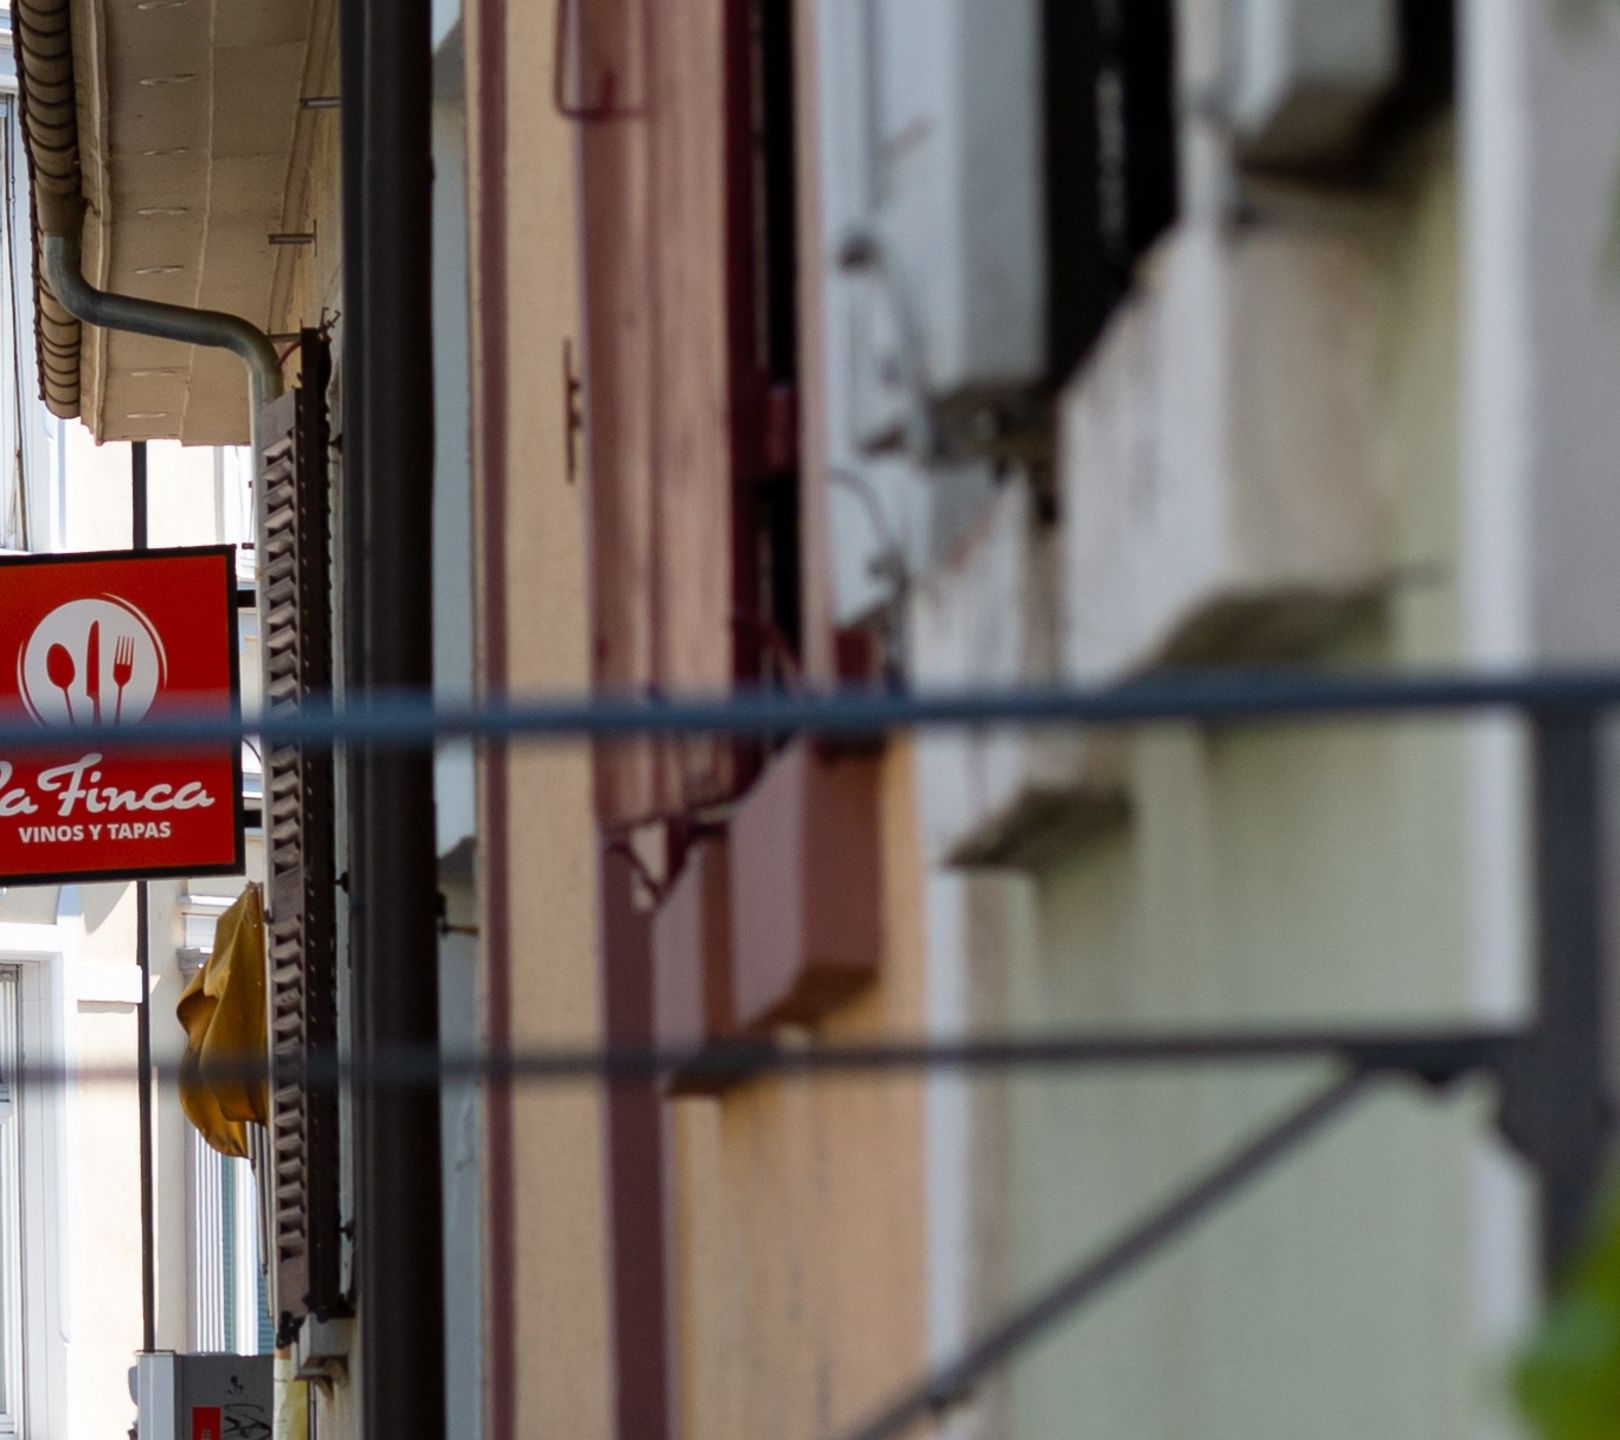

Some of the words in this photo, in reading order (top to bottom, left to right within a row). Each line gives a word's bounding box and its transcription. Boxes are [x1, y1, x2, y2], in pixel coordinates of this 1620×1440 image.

[37, 752, 215, 817] Finca
[18, 824, 84, 844] VINOS
[88, 824, 103, 841] Y
[107, 821, 171, 841] TAPAS
